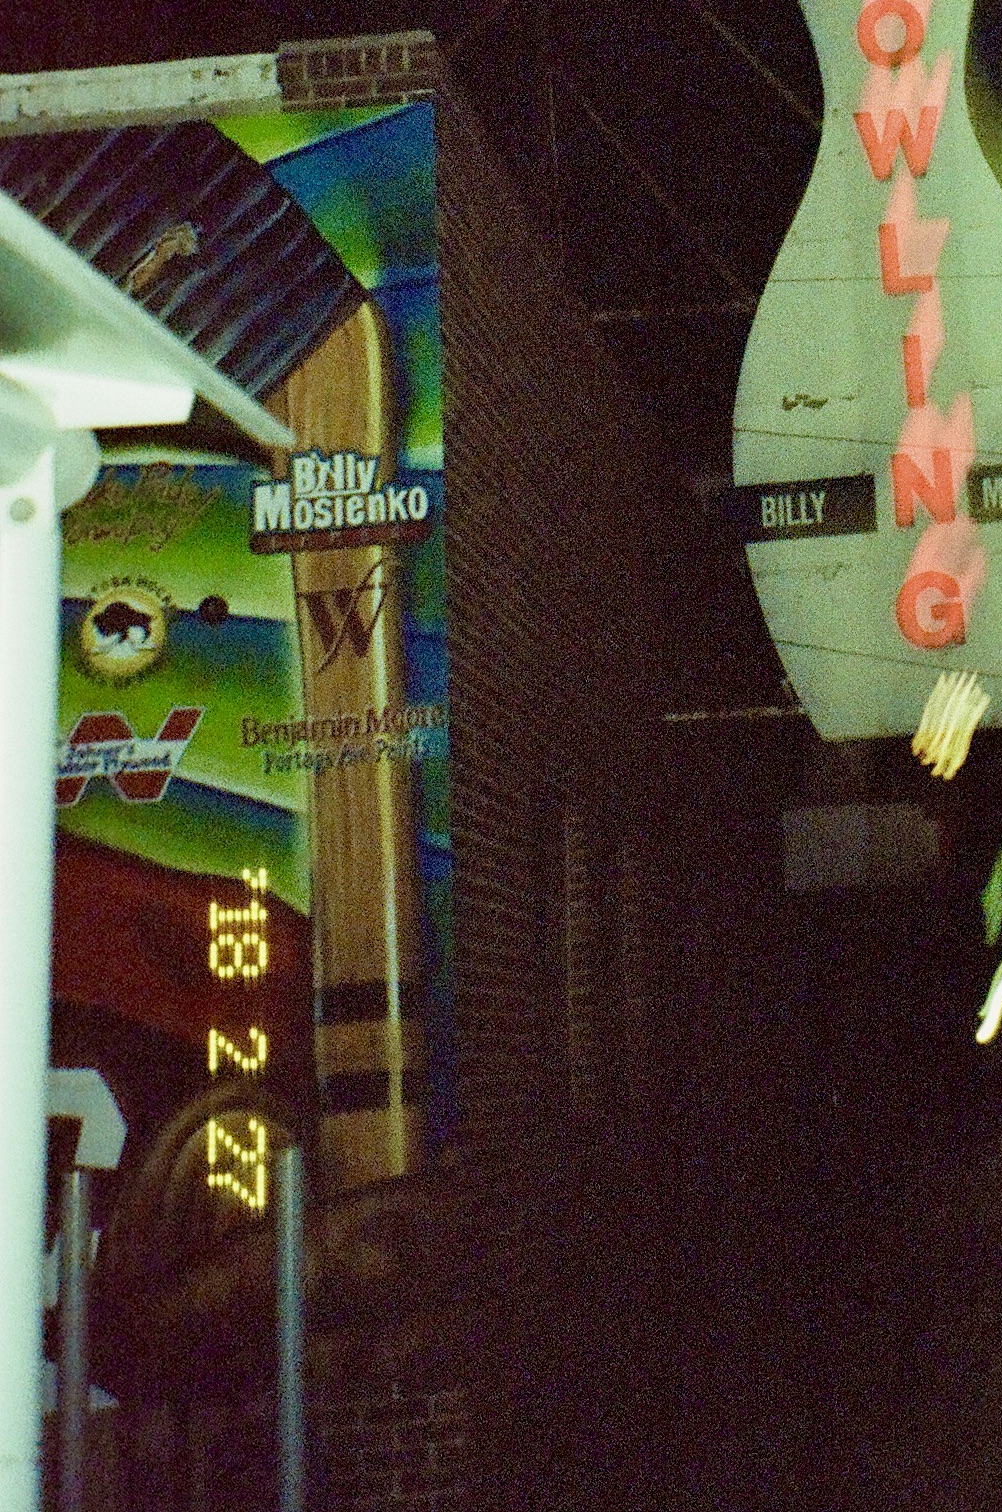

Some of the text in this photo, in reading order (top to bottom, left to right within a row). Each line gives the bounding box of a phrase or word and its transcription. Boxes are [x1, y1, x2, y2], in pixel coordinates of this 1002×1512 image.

[292, 451, 377, 494] Billy
[253, 484, 428, 532] Mosienko
[760, 491, 826, 528] BILLY
[241, 711, 361, 748] Benjamin
